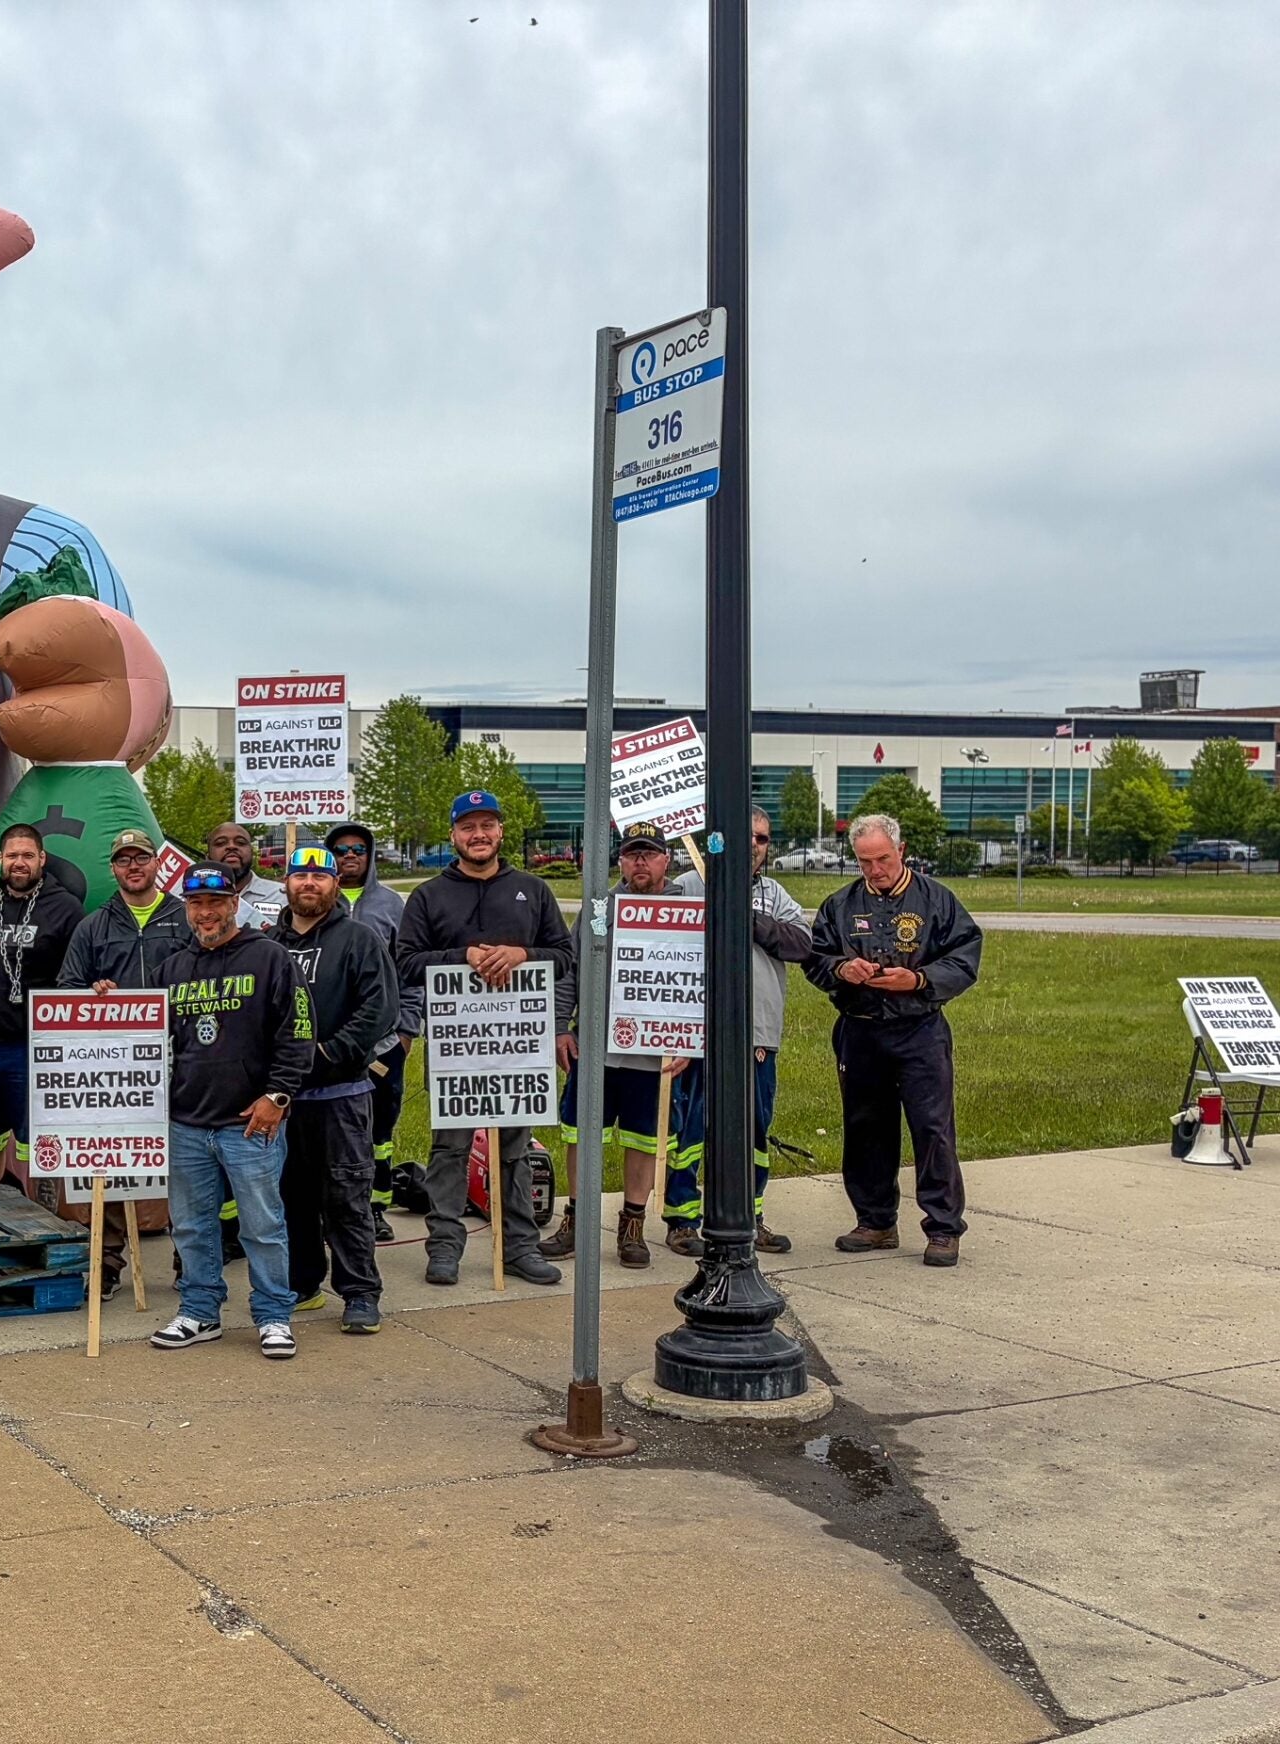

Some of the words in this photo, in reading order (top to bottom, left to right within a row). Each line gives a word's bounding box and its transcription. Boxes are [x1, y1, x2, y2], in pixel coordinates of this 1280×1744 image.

[663, 328, 710, 366] pace
[634, 382, 660, 405] BUS
[666, 367, 703, 393] STOP
[648, 410, 683, 449] 316
[636, 463, 692, 488] PaceBus.com
[682, 478, 699, 487] Center
[664, 484, 714, 503] RTAChicago.com
[241, 684, 270, 700] ON
[274, 682, 342, 699] STRIKE
[240, 722, 261, 731] ULP
[265, 719, 314, 730] AGAINST
[320, 718, 341, 727] ULP
[240, 737, 341, 754] BREAKTHRU
[480, 733, 500, 743] 3333
[611, 746, 621, 758] N
[625, 724, 689, 753] STRIKE
[246, 754, 336, 770] BEVERAGE
[628, 755, 674, 776] AGAINST
[679, 748, 701, 758] ULP
[610, 762, 706, 798] BREAKTHRU
[264, 790, 345, 802] TEAMSTERS
[618, 774, 706, 808] BEVERAGE
[264, 804, 314, 816] LOCAL
[317, 803, 345, 814] 710
[648, 803, 707, 826] TEAMST
[661, 815, 703, 834] OCAL
[620, 906, 652, 923] ON
[656, 908, 705, 925] STRI
[620, 949, 642, 959] ULP
[648, 950, 703, 962] AGAINST
[433, 972, 463, 996] ON
[469, 968, 547, 994] SIKE
[618, 969, 705, 987] BREAKTH
[169, 977, 220, 1005] LOCAL
[221, 973, 255, 999] 710
[624, 986, 705, 1004] BEVERA
[1185, 981, 1209, 994] ON
[1207, 981, 1261, 994] STRIKE
[36, 1003, 72, 1022] ON
[77, 1003, 161, 1022] STRIKE
[176, 998, 241, 1016] STEWARD
[432, 1004, 455, 1014] ULP
[460, 1001, 516, 1013] AGAINST
[522, 1000, 545, 1011] ULP
[1200, 1009, 1273, 1019] BREAKTHRU
[294, 1019, 311, 1031] 710
[432, 1021, 546, 1039] BREAKTHRU
[641, 1020, 704, 1035] TEAMST
[1210, 1020, 1276, 1029] BEVERAGE
[440, 1039, 540, 1057] BEVERAGE
[640, 1035, 696, 1050] LOCAL
[1219, 1041, 1280, 1054] TEAMSTE
[36, 1049, 61, 1061] ULP
[68, 1047, 129, 1060] AGAINST
[135, 1046, 160, 1058] ULP
[1227, 1053, 1275, 1066] LOCAL
[36, 1070, 161, 1089] BREAKTHRU
[436, 1073, 550, 1097] TEAMSTERS
[44, 1090, 155, 1109] BEVERAGE
[438, 1095, 505, 1117] LOCAL
[509, 1094, 547, 1115] 710
[66, 1136, 165, 1151] TEAMSTERS
[66, 1153, 127, 1168] LOCAL
[131, 1153, 165, 1167] 710
